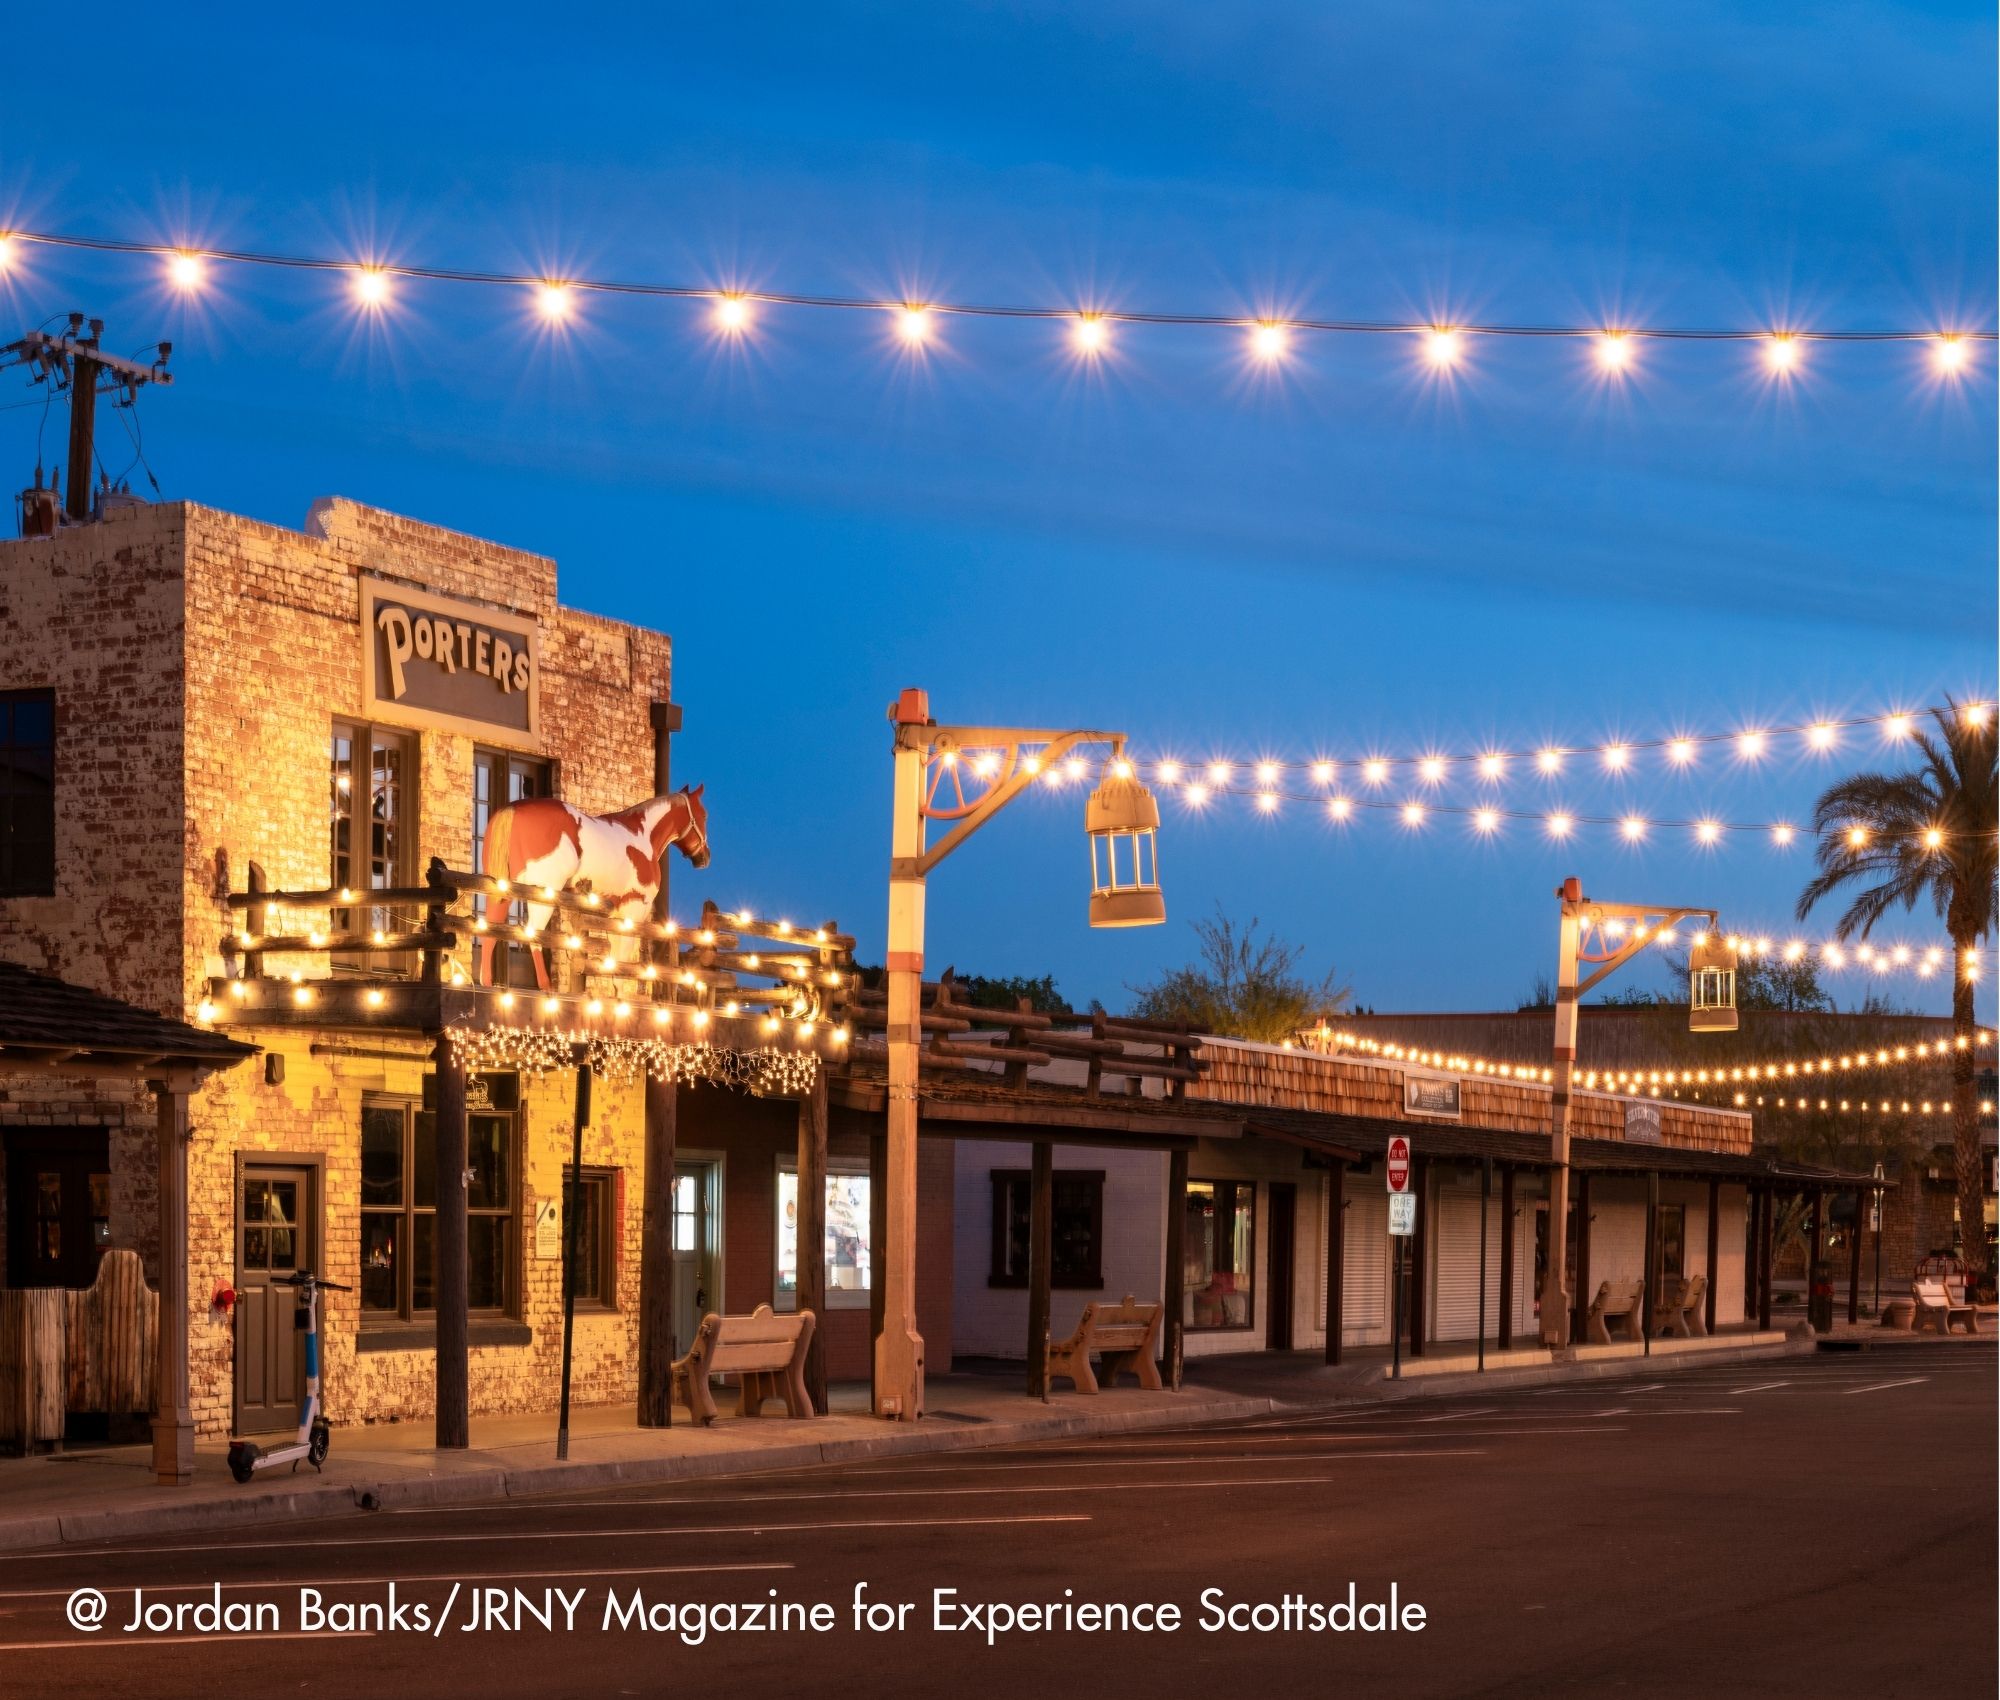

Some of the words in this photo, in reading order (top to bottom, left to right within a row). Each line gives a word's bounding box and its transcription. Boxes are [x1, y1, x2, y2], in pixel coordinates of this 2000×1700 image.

[378, 607, 530, 700] PORTERS
[1391, 1149, 1398, 1158] DO
[1391, 1172, 1404, 1182] ENTER
[1394, 1198, 1412, 1208] ONE
[1394, 1208, 1412, 1219] WAY
